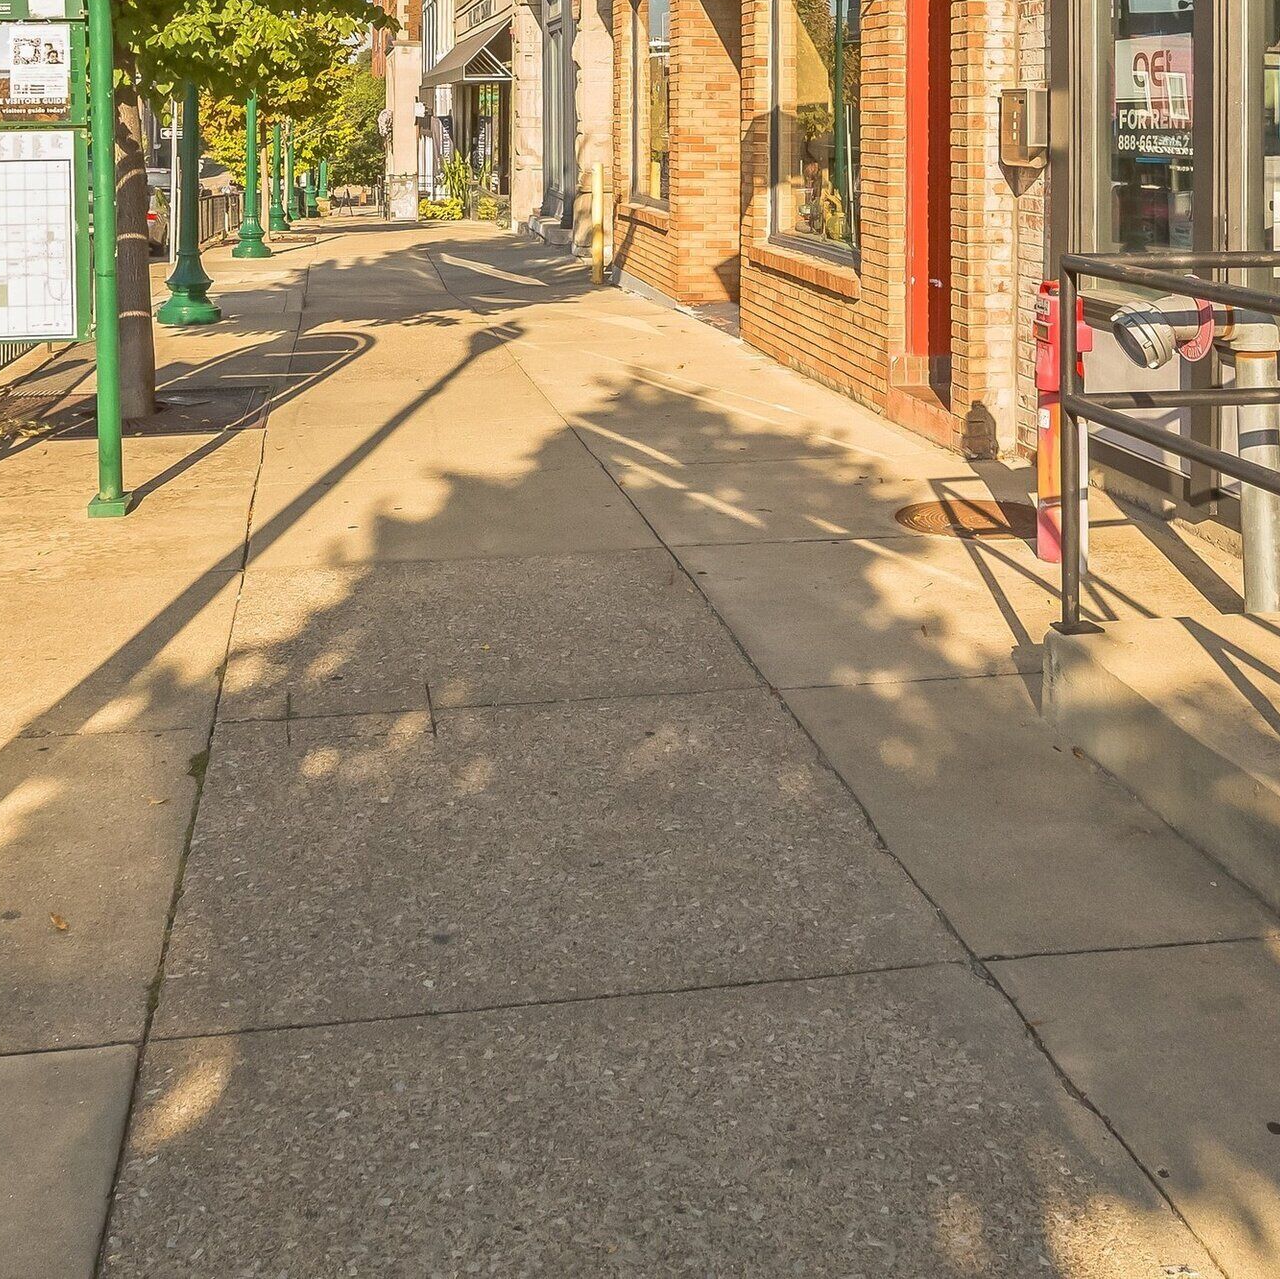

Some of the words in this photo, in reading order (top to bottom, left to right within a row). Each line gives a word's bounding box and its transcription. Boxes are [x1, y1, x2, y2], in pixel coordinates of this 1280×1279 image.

[42, 97, 67, 105] GUIDE
[47, 107, 67, 115] today!
[1119, 109, 1148, 129] FOR
